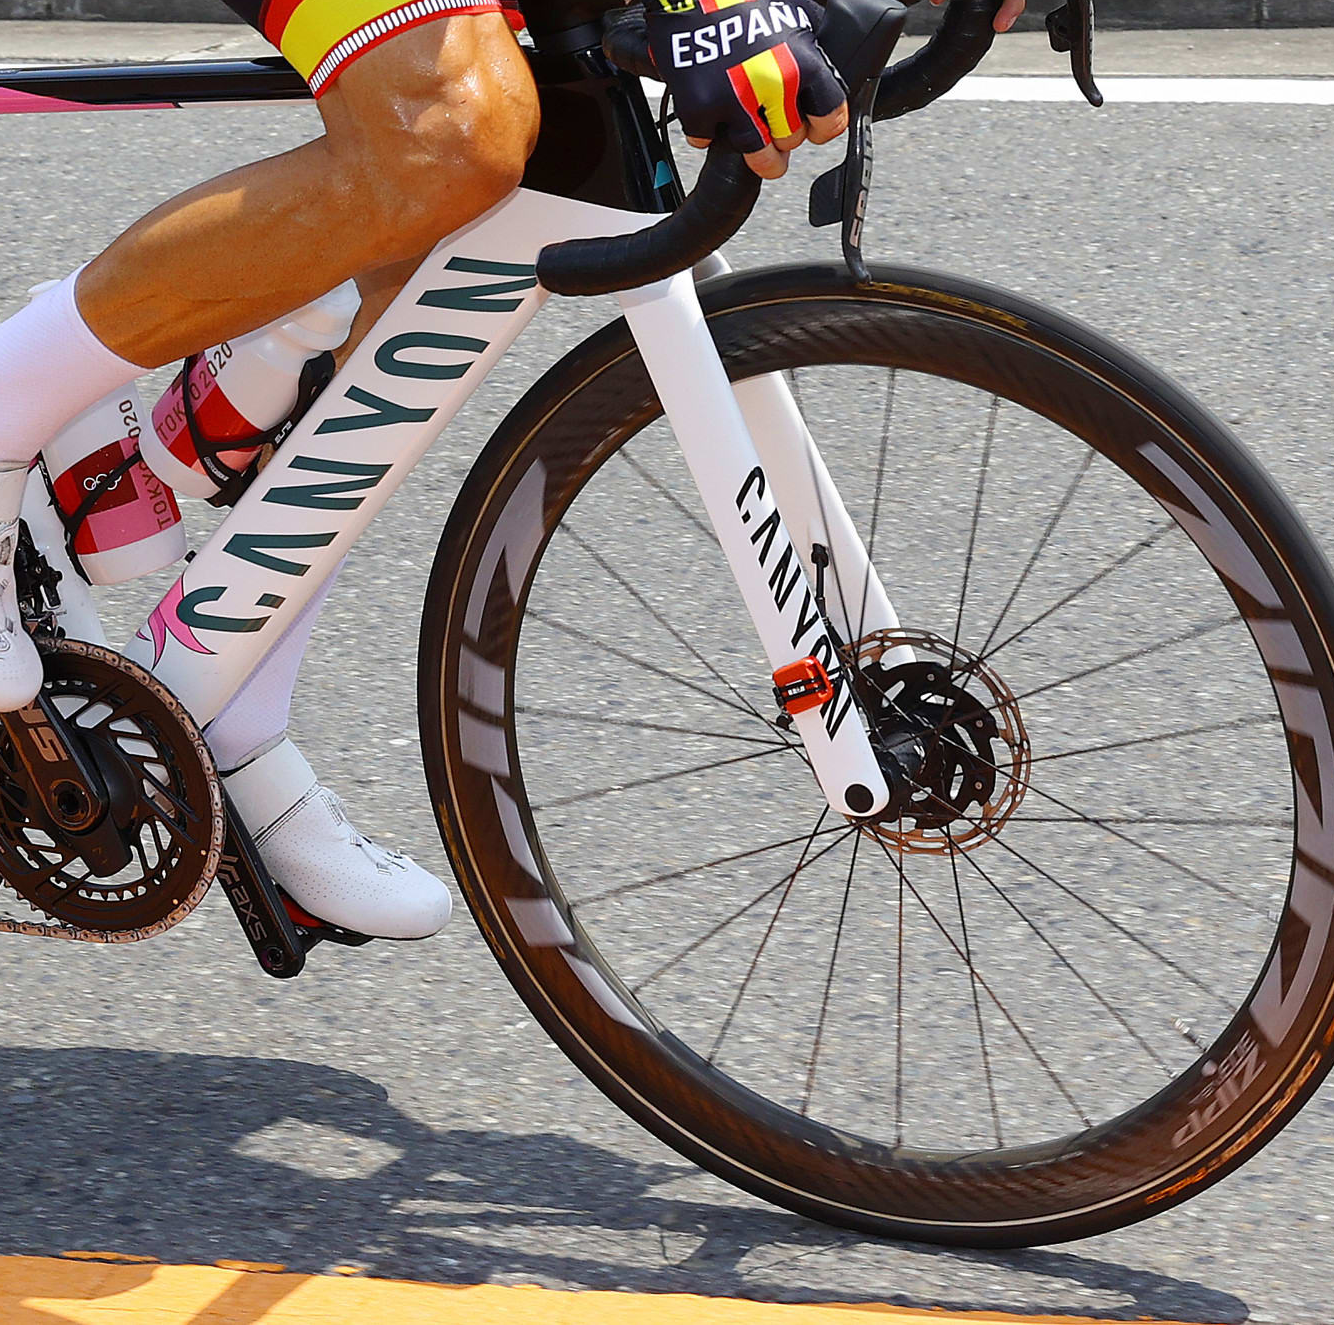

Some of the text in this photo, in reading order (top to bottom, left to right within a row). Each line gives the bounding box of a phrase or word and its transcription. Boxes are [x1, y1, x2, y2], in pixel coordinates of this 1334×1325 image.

[671, 1, 814, 68] ESPAÑA
[156, 341, 234, 442] TOKO 2020
[176, 256, 538, 633] CANYON
[735, 465, 855, 742] CANYON
[1171, 1036, 1267, 1149] ZIPP
